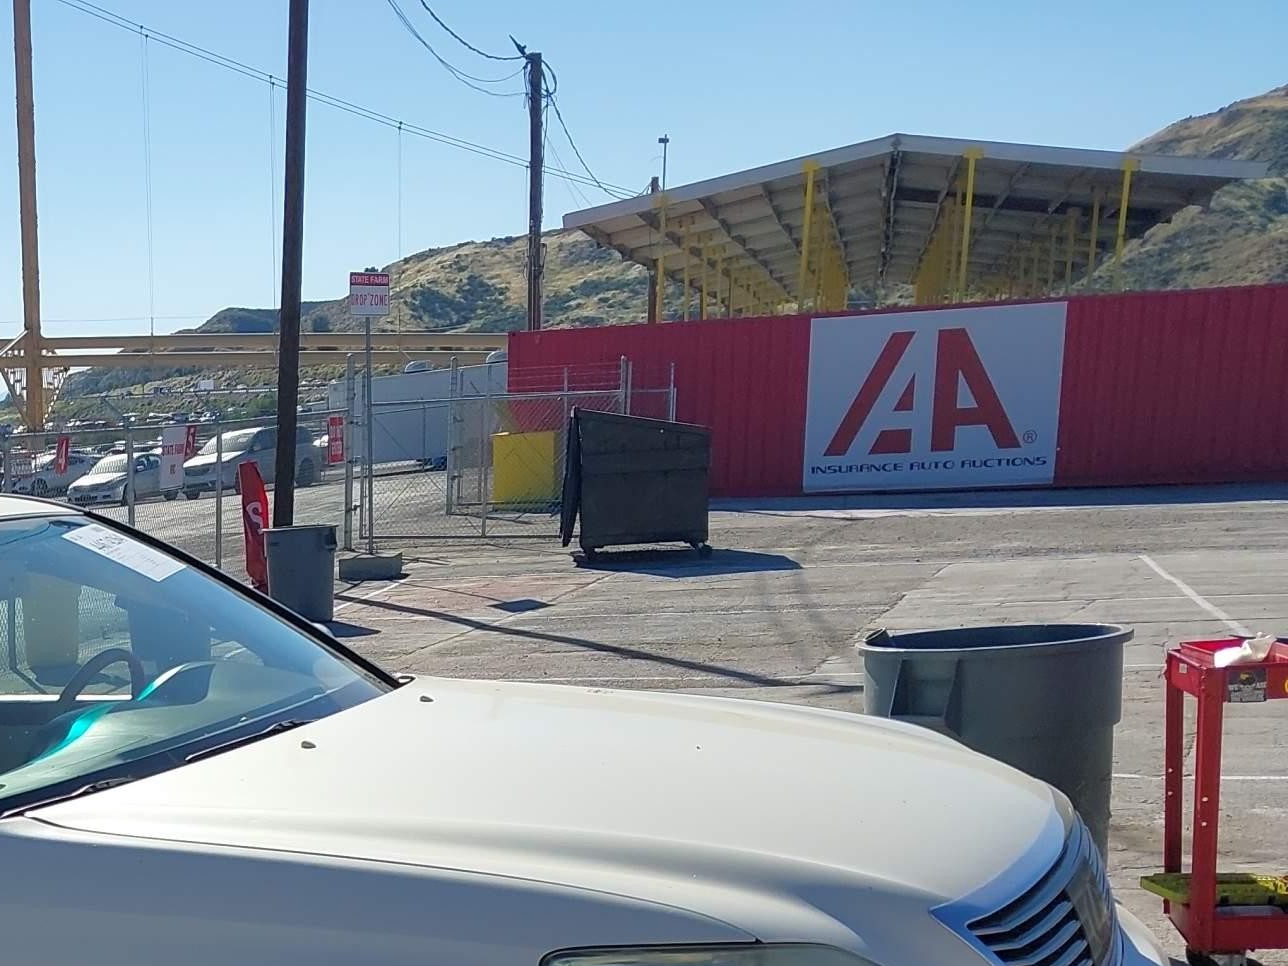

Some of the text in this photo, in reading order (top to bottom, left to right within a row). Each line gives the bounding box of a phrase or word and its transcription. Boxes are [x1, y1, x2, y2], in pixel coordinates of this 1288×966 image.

[352, 275, 388, 284] STATE FARM
[370, 294, 388, 306] ZONE
[811, 456, 1048, 475] INSURANCE AUTO AUCTIONS
